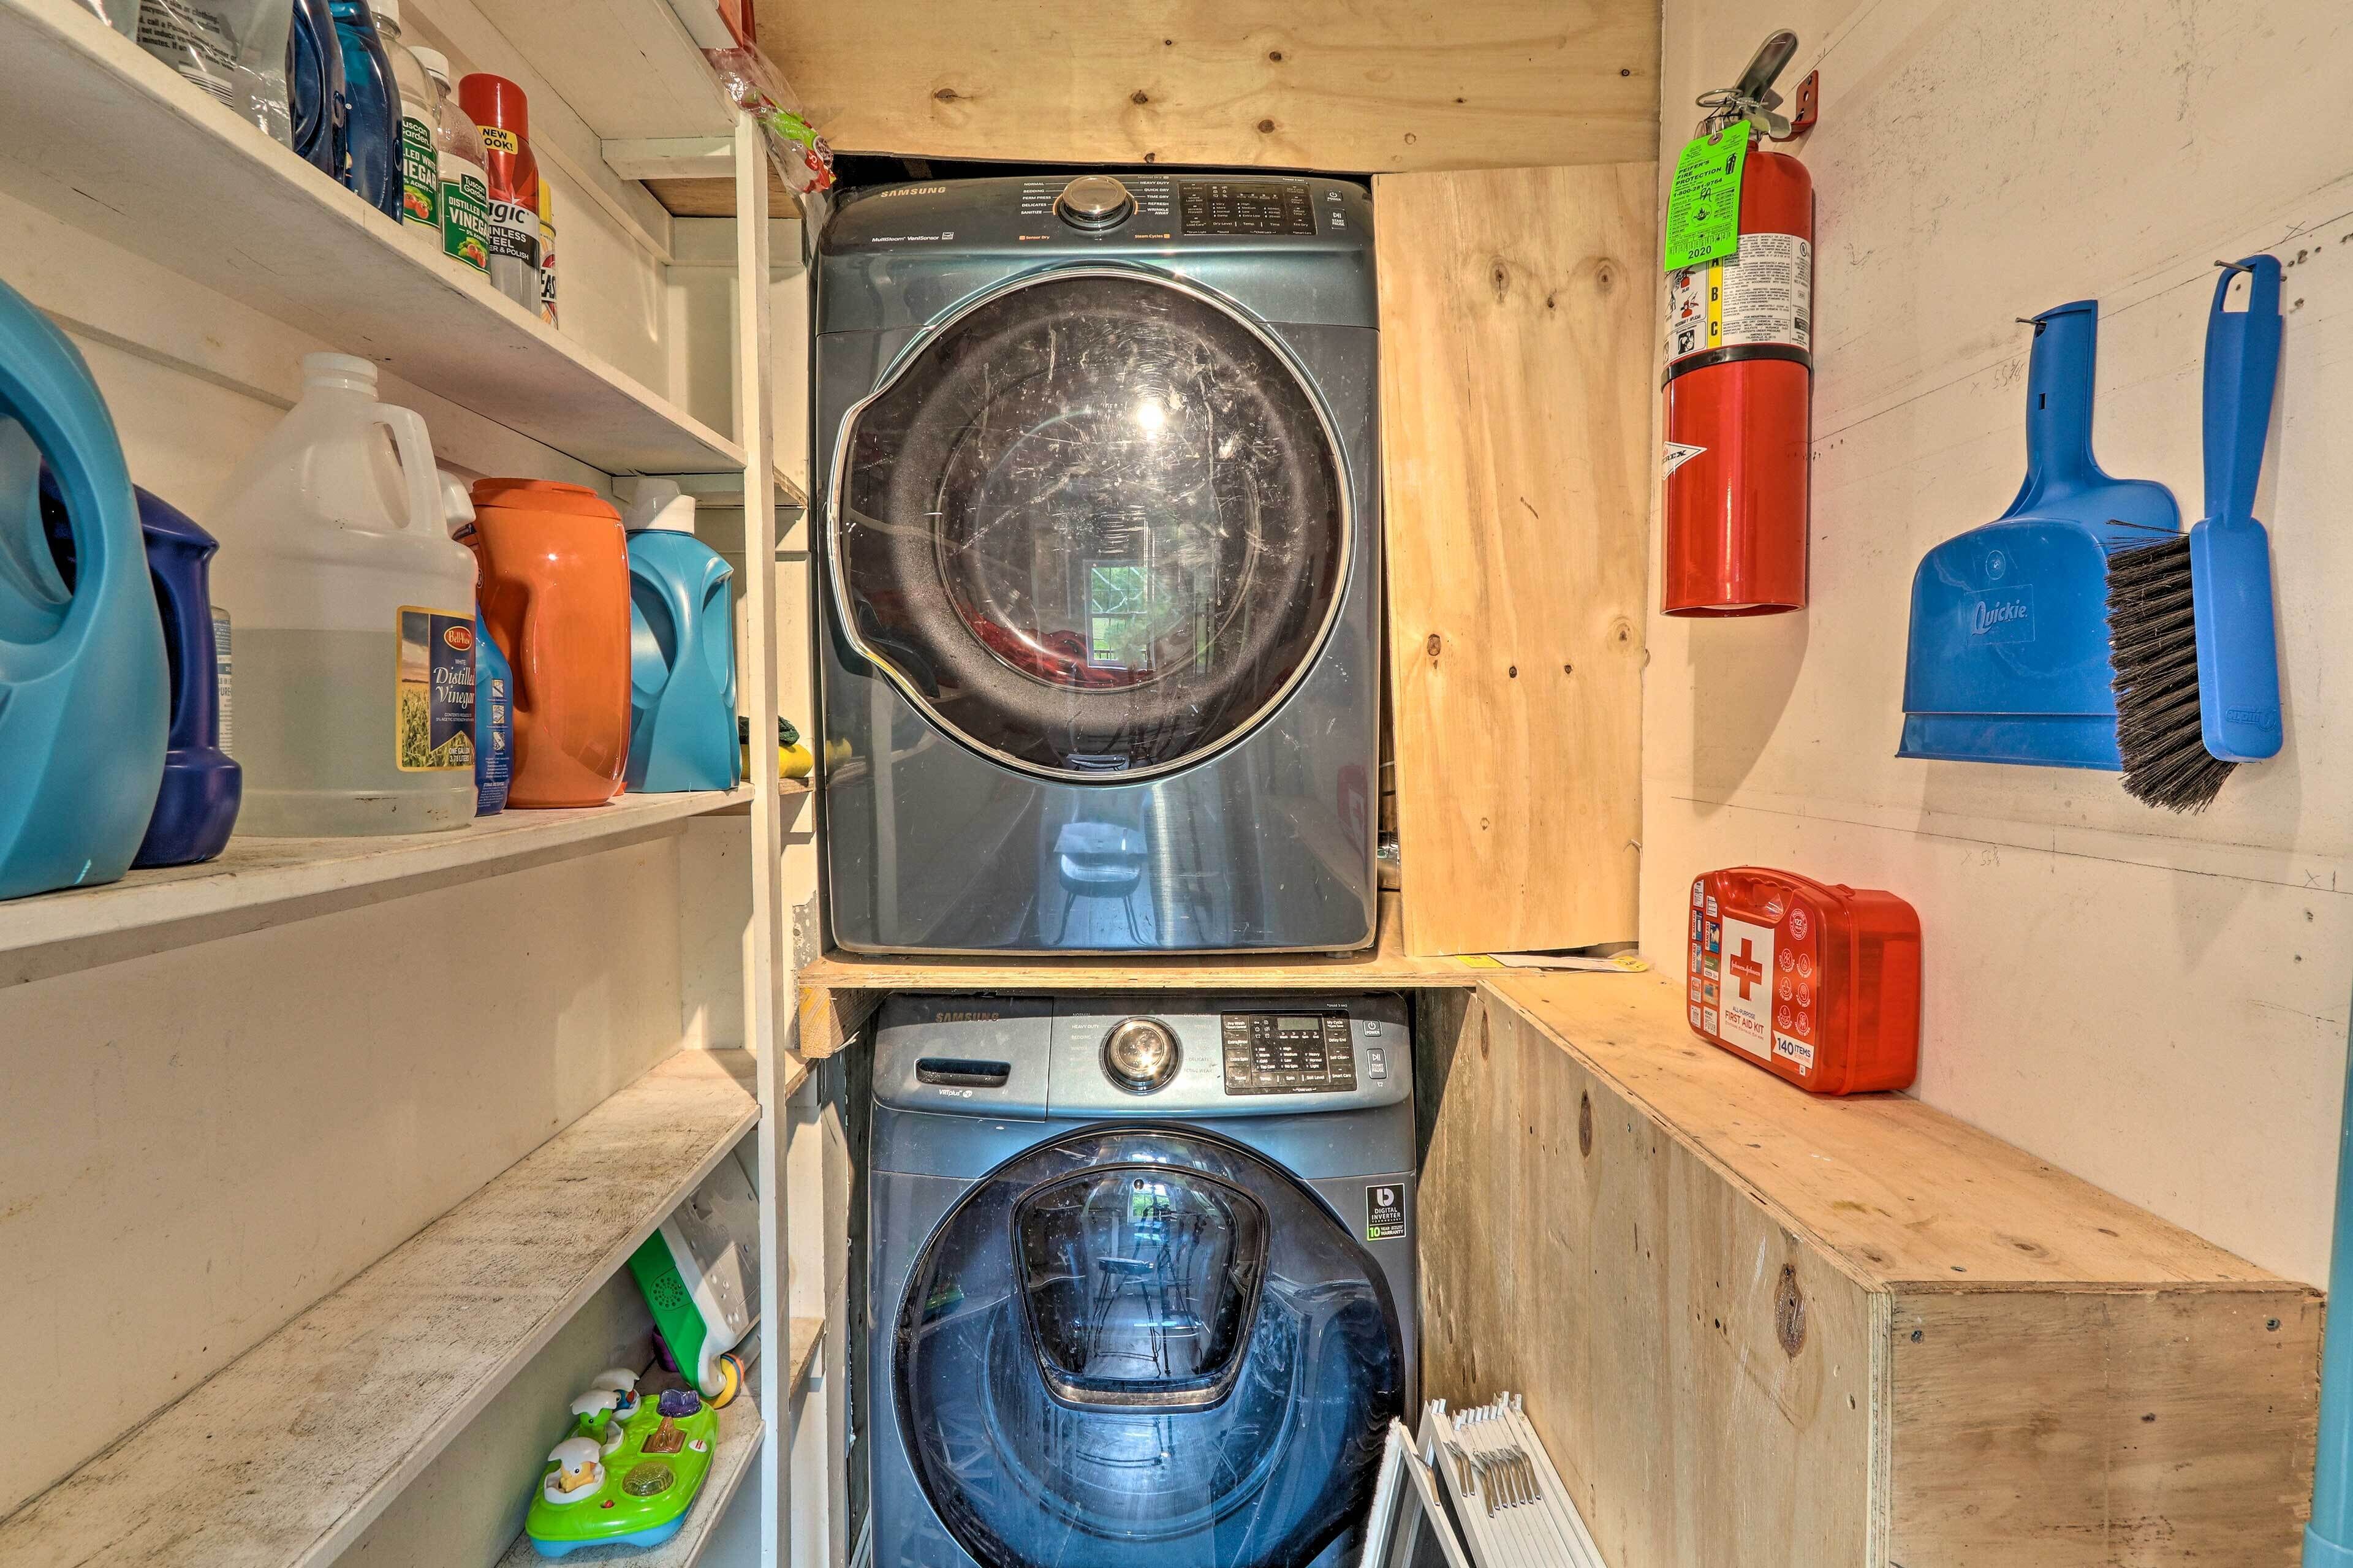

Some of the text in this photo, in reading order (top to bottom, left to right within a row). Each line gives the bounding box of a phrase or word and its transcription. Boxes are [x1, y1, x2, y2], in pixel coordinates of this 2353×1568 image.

[147, 17, 159, 26] call
[143, 37, 170, 48] minutes.
[403, 121, 428, 137] uscan
[483, 127, 507, 140] NEW
[484, 137, 513, 152] OOK!
[1679, 160, 1710, 174] PEIFER'S
[1676, 167, 1722, 186] PROTECTION
[1677, 171, 1692, 180] FIRE
[464, 176, 486, 195] Tuscan
[881, 186, 947, 197] SAMSUNG
[464, 185, 487, 202] Garden
[449, 195, 480, 216] DISTILLED
[506, 248, 529, 260] POLISH
[1688, 245, 1711, 260] 2020
[1711, 287, 1718, 301] B
[1711, 322, 1718, 336] C
[1971, 599, 2028, 637] Quickie
[449, 630, 471, 644] Bell-View
[935, 1012, 999, 1023] SAMSUNG
[1732, 1006, 1756, 1020] ALL-PURPOSE
[1725, 1010, 1740, 1025] FIRST
[1742, 1017, 1752, 1029] AID
[1754, 1022, 1764, 1035] KIT
[1777, 1037, 1811, 1058] 140 ITEMS
[1369, 1227, 1381, 1238] 10
